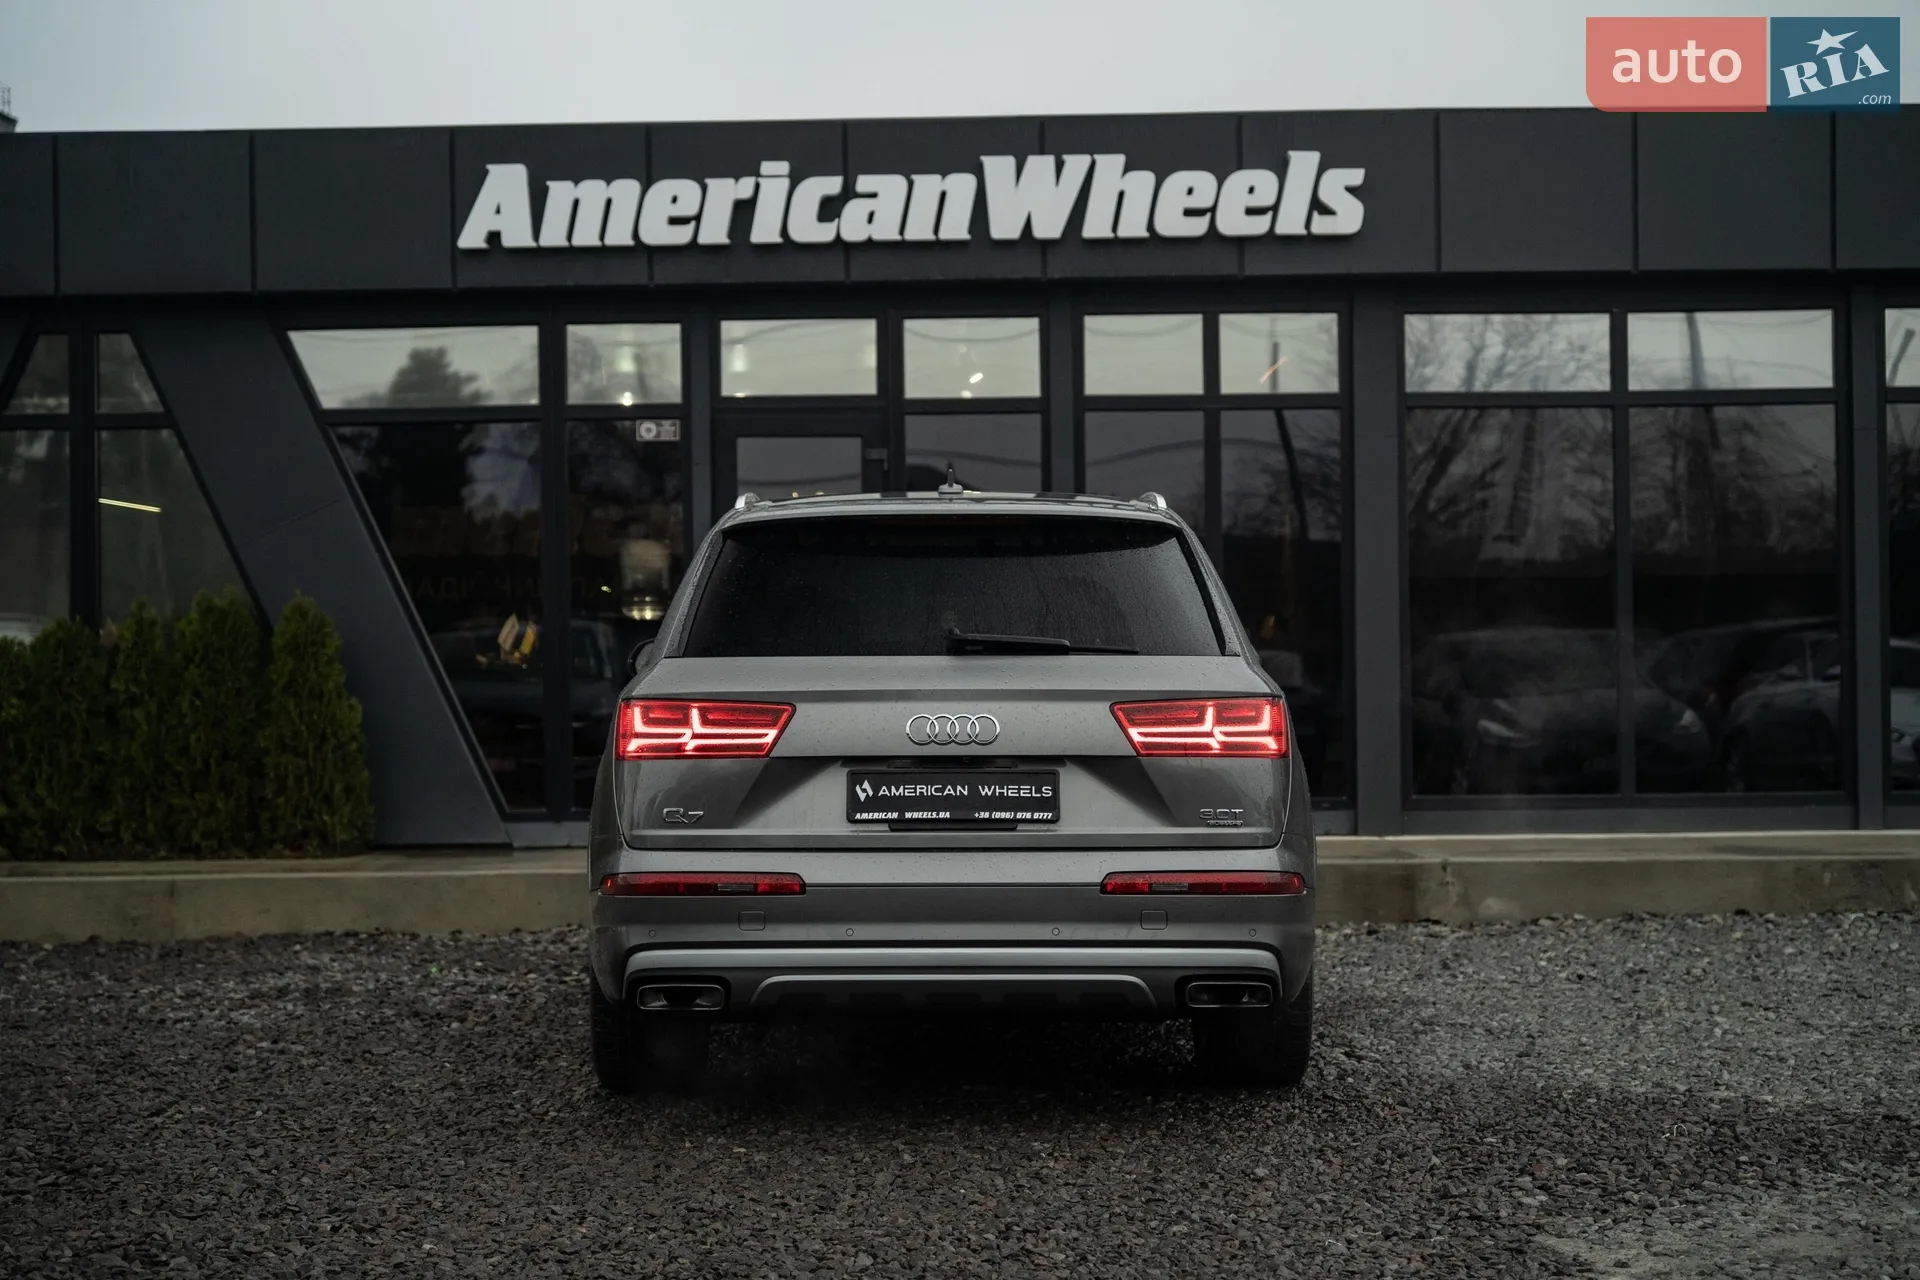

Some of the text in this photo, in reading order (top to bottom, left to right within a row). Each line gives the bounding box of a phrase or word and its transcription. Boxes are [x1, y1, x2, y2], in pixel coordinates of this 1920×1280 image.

[878, 784, 1053, 798] AMERICAN WHEELS
[663, 807, 704, 824] Q7
[855, 811, 899, 820] AMERICAN
[904, 811, 951, 819] WHEELS.UA
[974, 811, 989, 819] +38
[991, 811, 1015, 819] (096)
